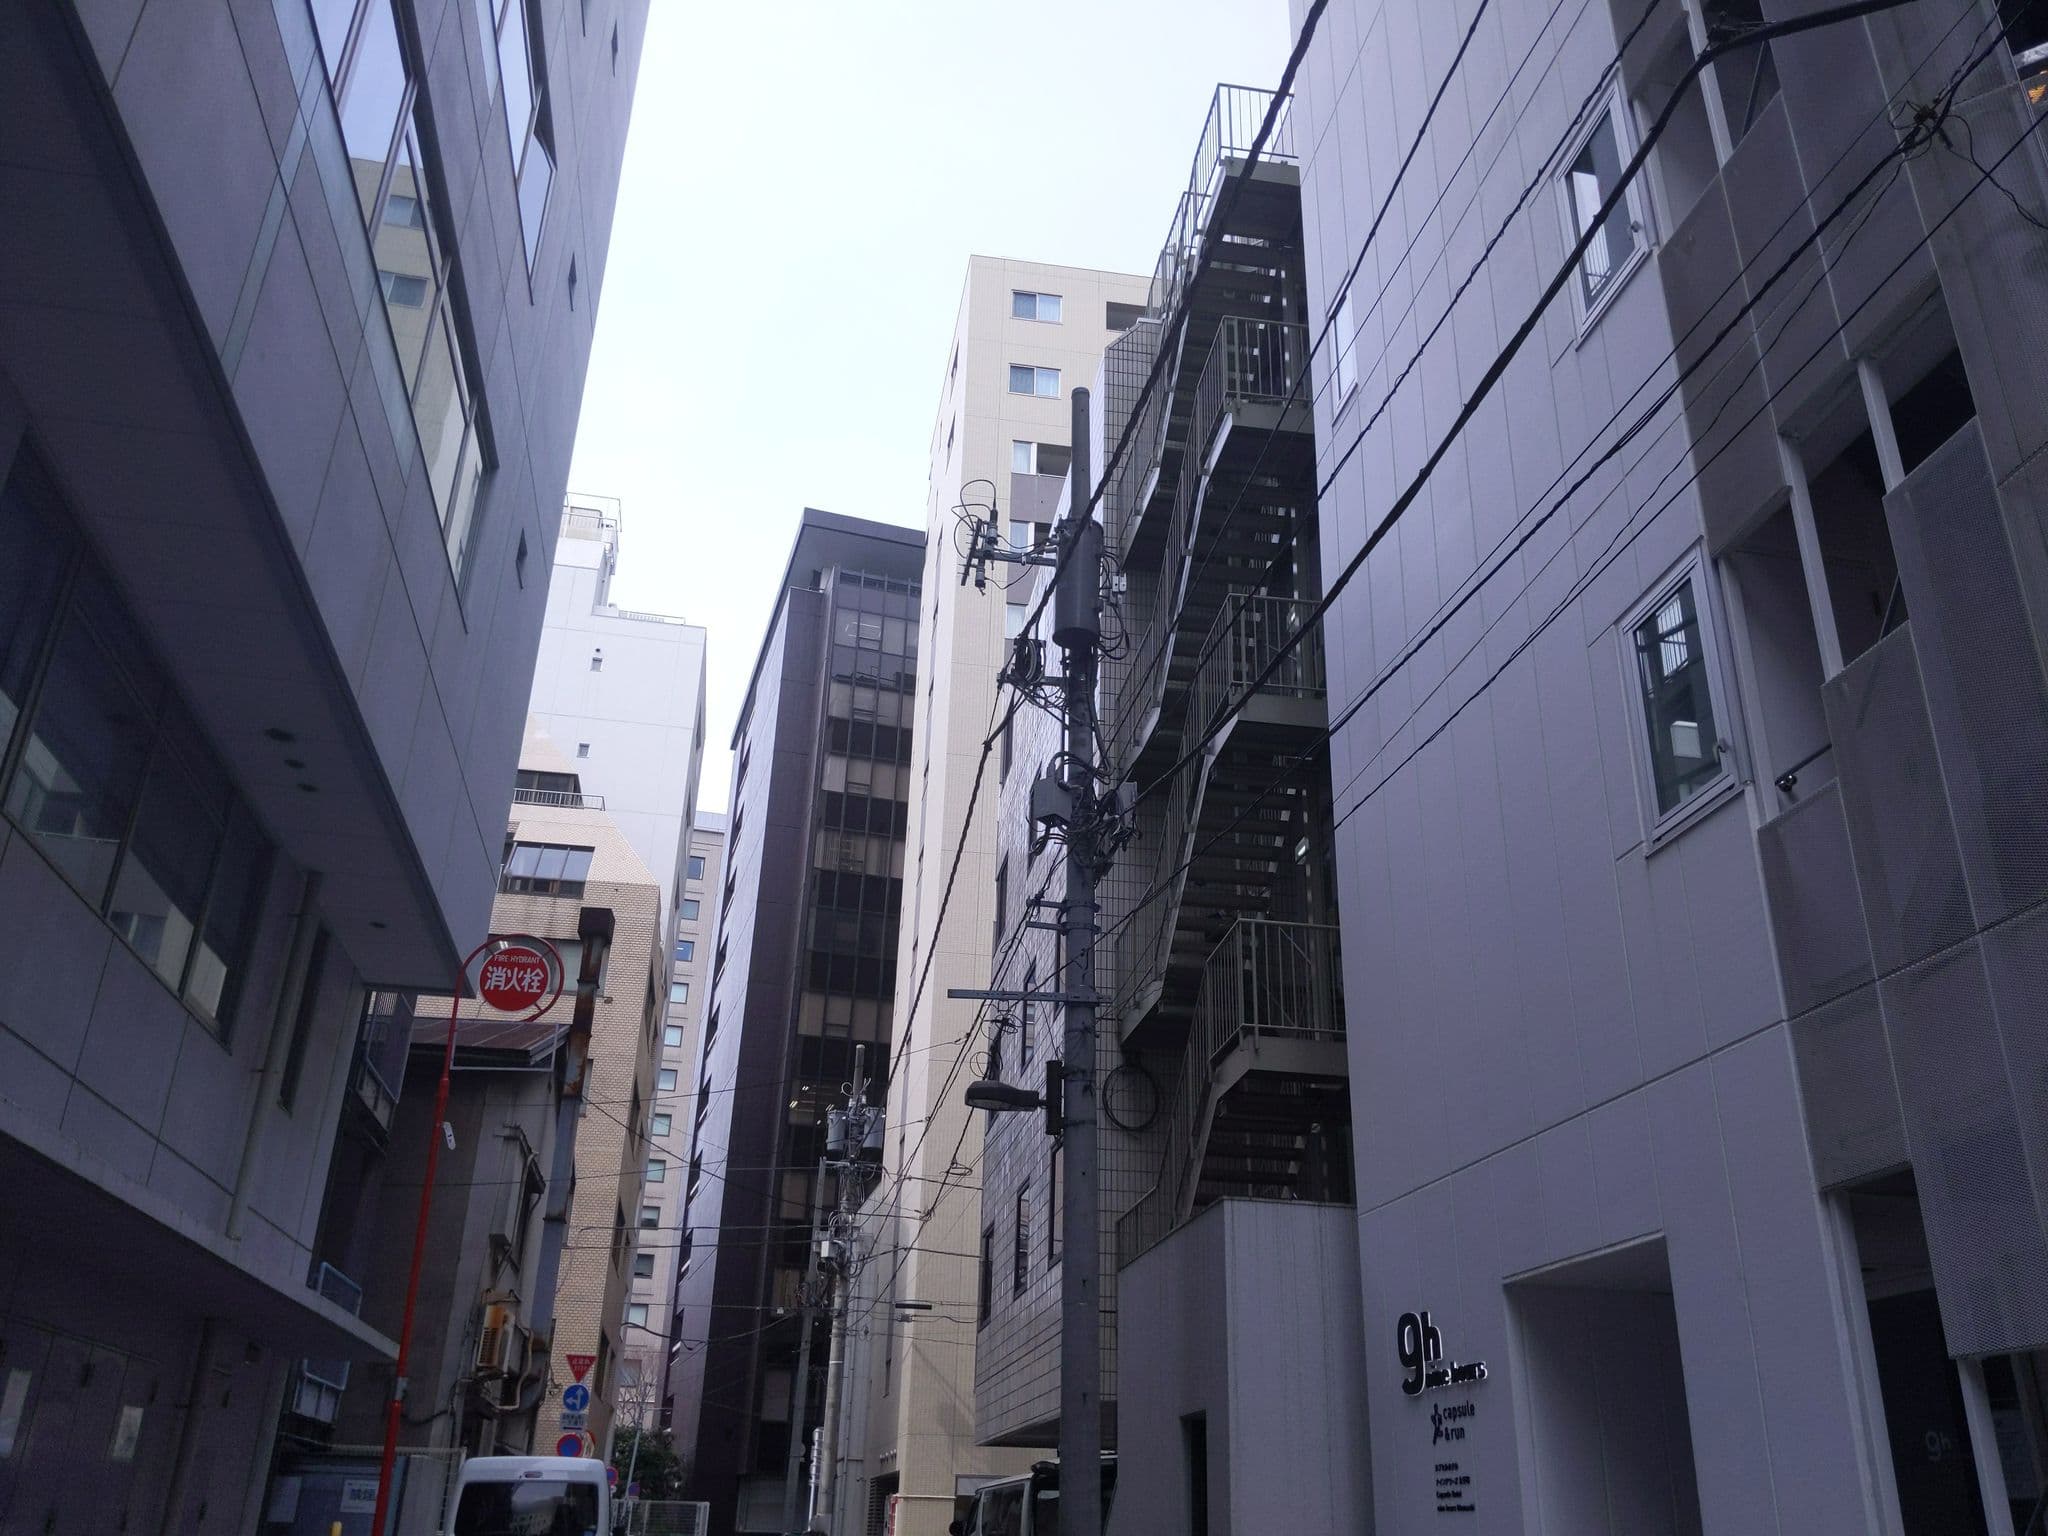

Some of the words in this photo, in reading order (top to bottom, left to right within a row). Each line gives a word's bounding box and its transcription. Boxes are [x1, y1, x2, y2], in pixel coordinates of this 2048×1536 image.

[494, 954, 509, 962] FIRE
[511, 955, 541, 964] HYDRANT
[484, 966, 545, 993] 消火栓
[1397, 1311, 1443, 1396] 9h
[1443, 1400, 1475, 1423] capsule
